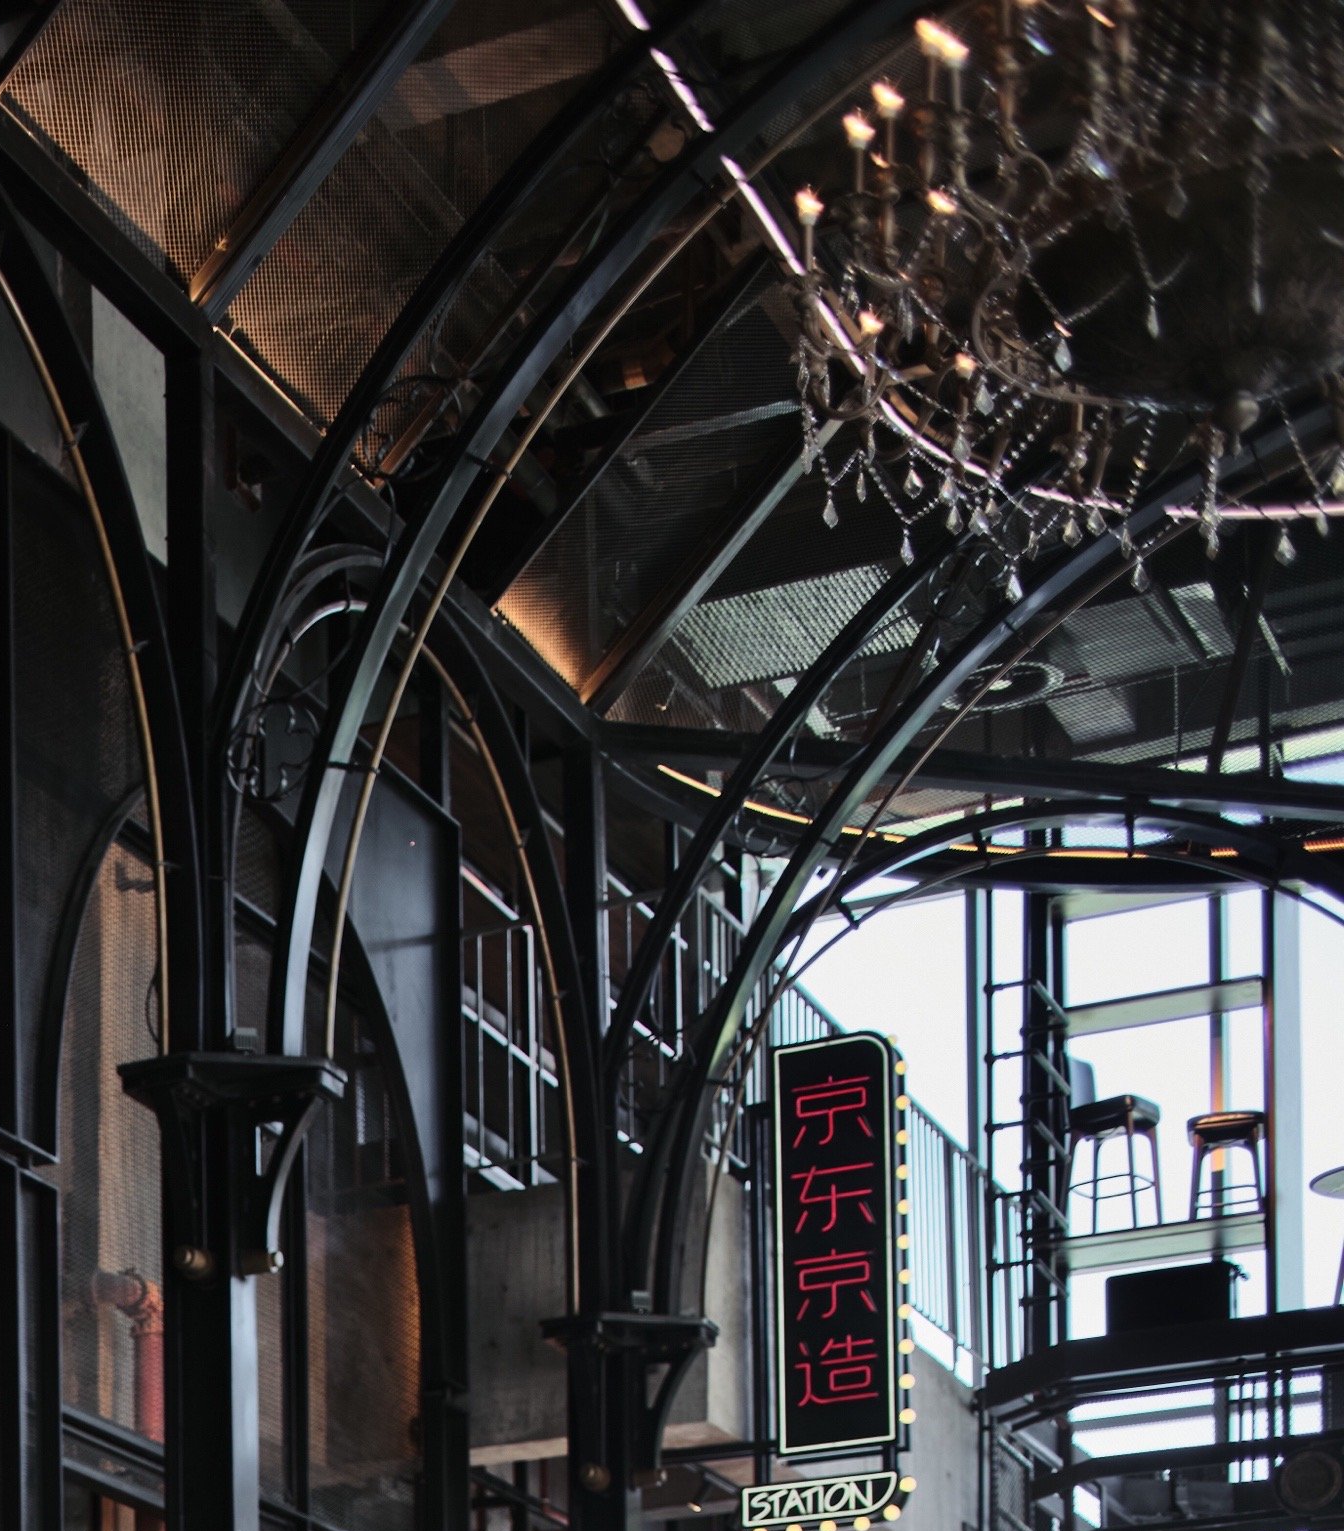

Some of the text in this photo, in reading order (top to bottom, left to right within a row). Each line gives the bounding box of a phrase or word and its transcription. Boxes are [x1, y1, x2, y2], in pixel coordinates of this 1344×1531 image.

[790, 1074, 879, 1408] 京东京造
[749, 1479, 874, 1522] STATION
